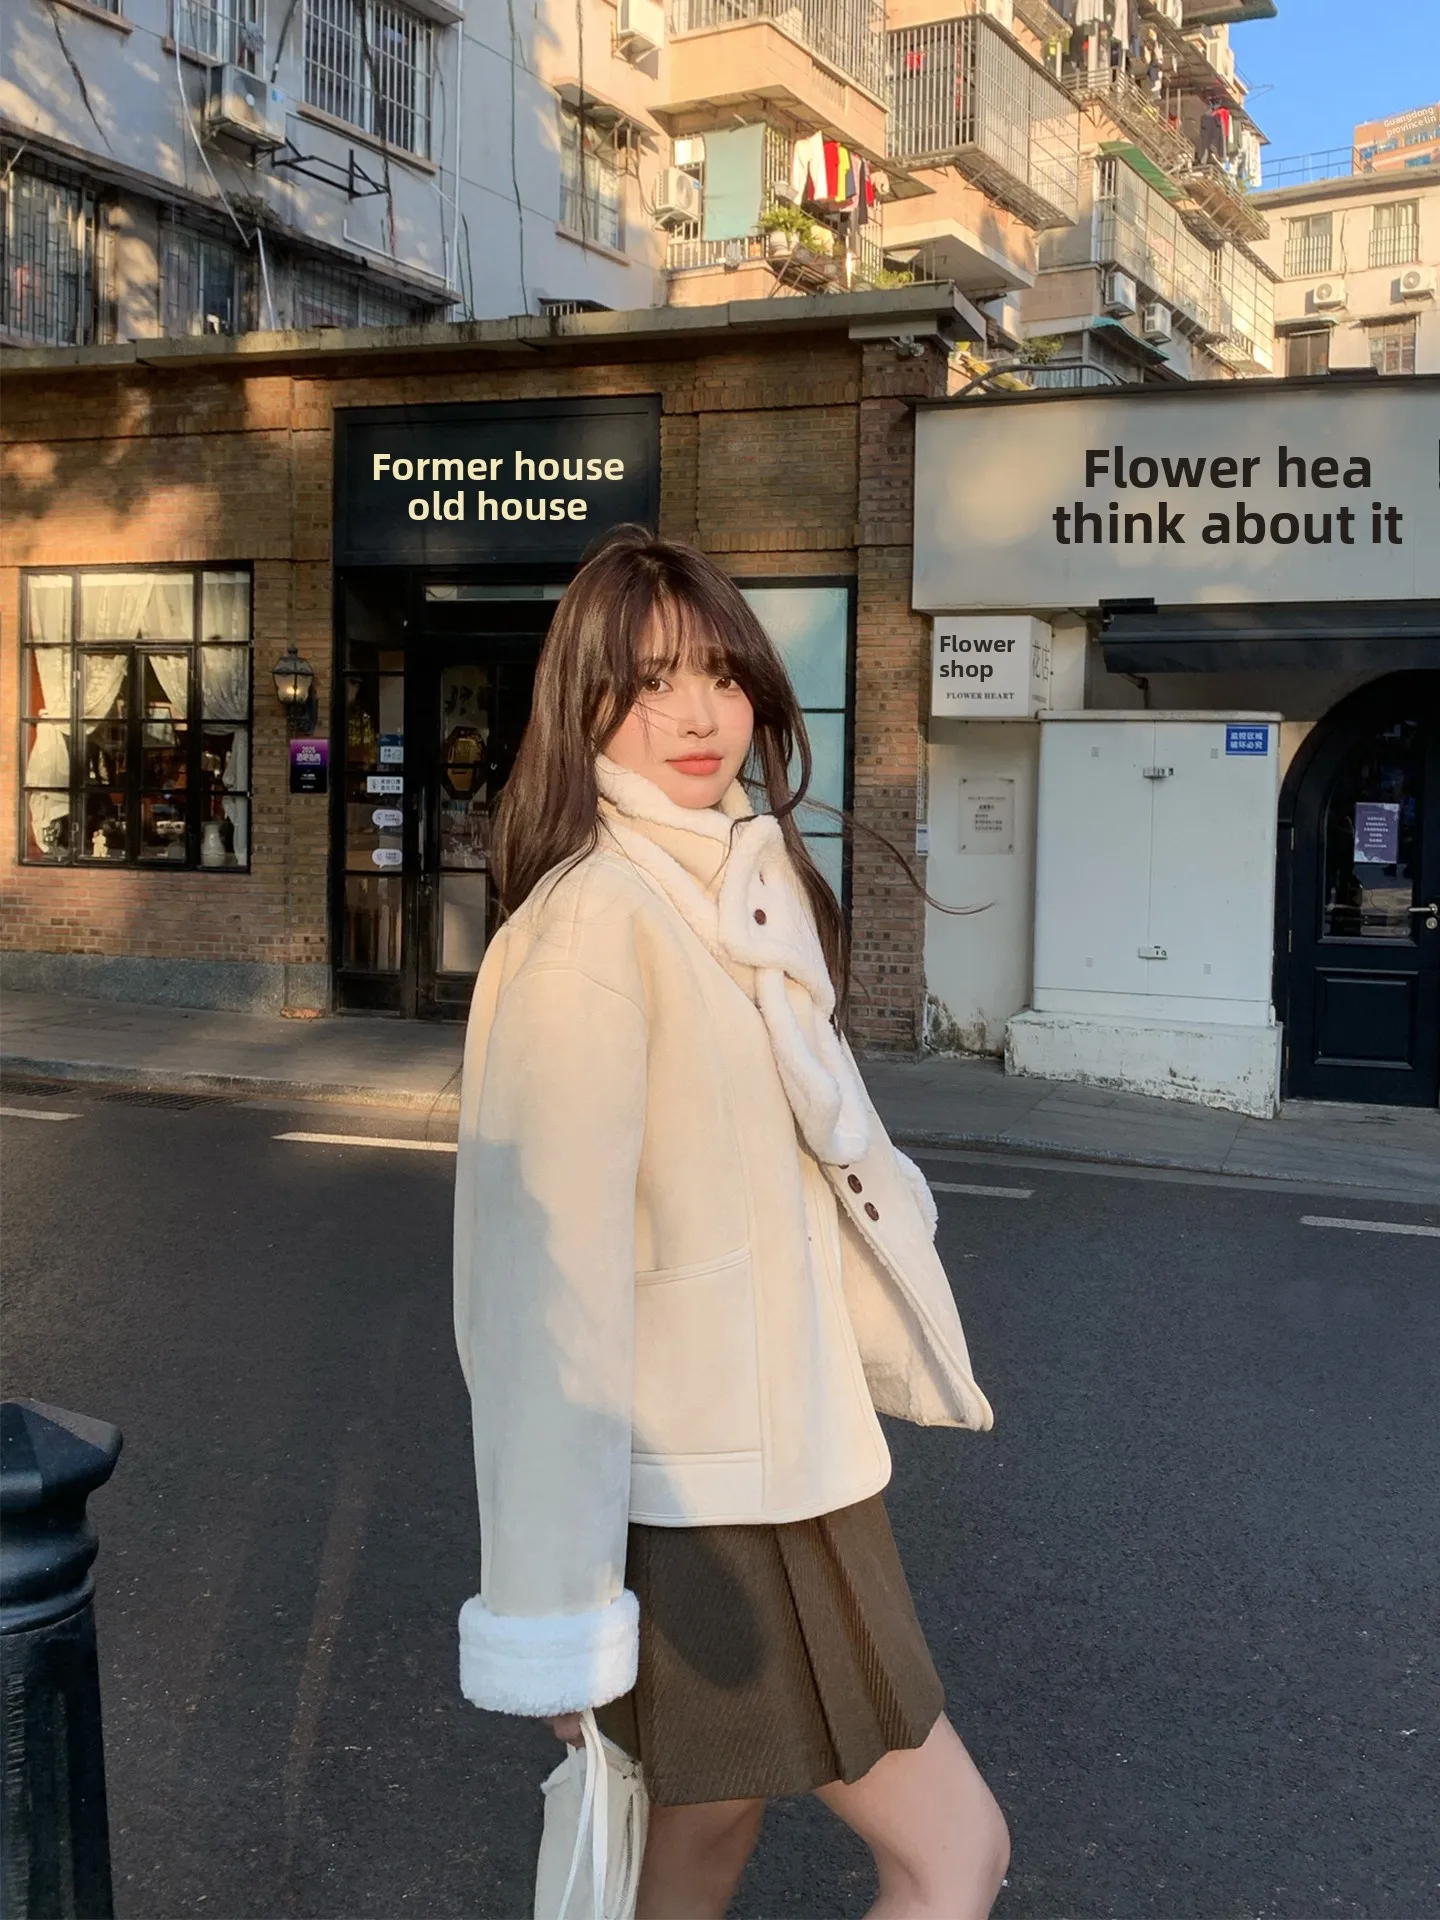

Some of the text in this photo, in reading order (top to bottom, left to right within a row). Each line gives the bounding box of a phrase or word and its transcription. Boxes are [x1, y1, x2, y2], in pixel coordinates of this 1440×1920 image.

[1383, 107, 1434, 128] Guangdong
[1386, 115, 1437, 139] province lin
[373, 450, 625, 481] Former house
[1085, 445, 1372, 489] Flower hea
[408, 490, 588, 521] old house
[1052, 501, 1403, 545] think about it
[940, 634, 1016, 653] Flower
[939, 659, 994, 683] shop
[946, 691, 1015, 700] FLOWER HEART
